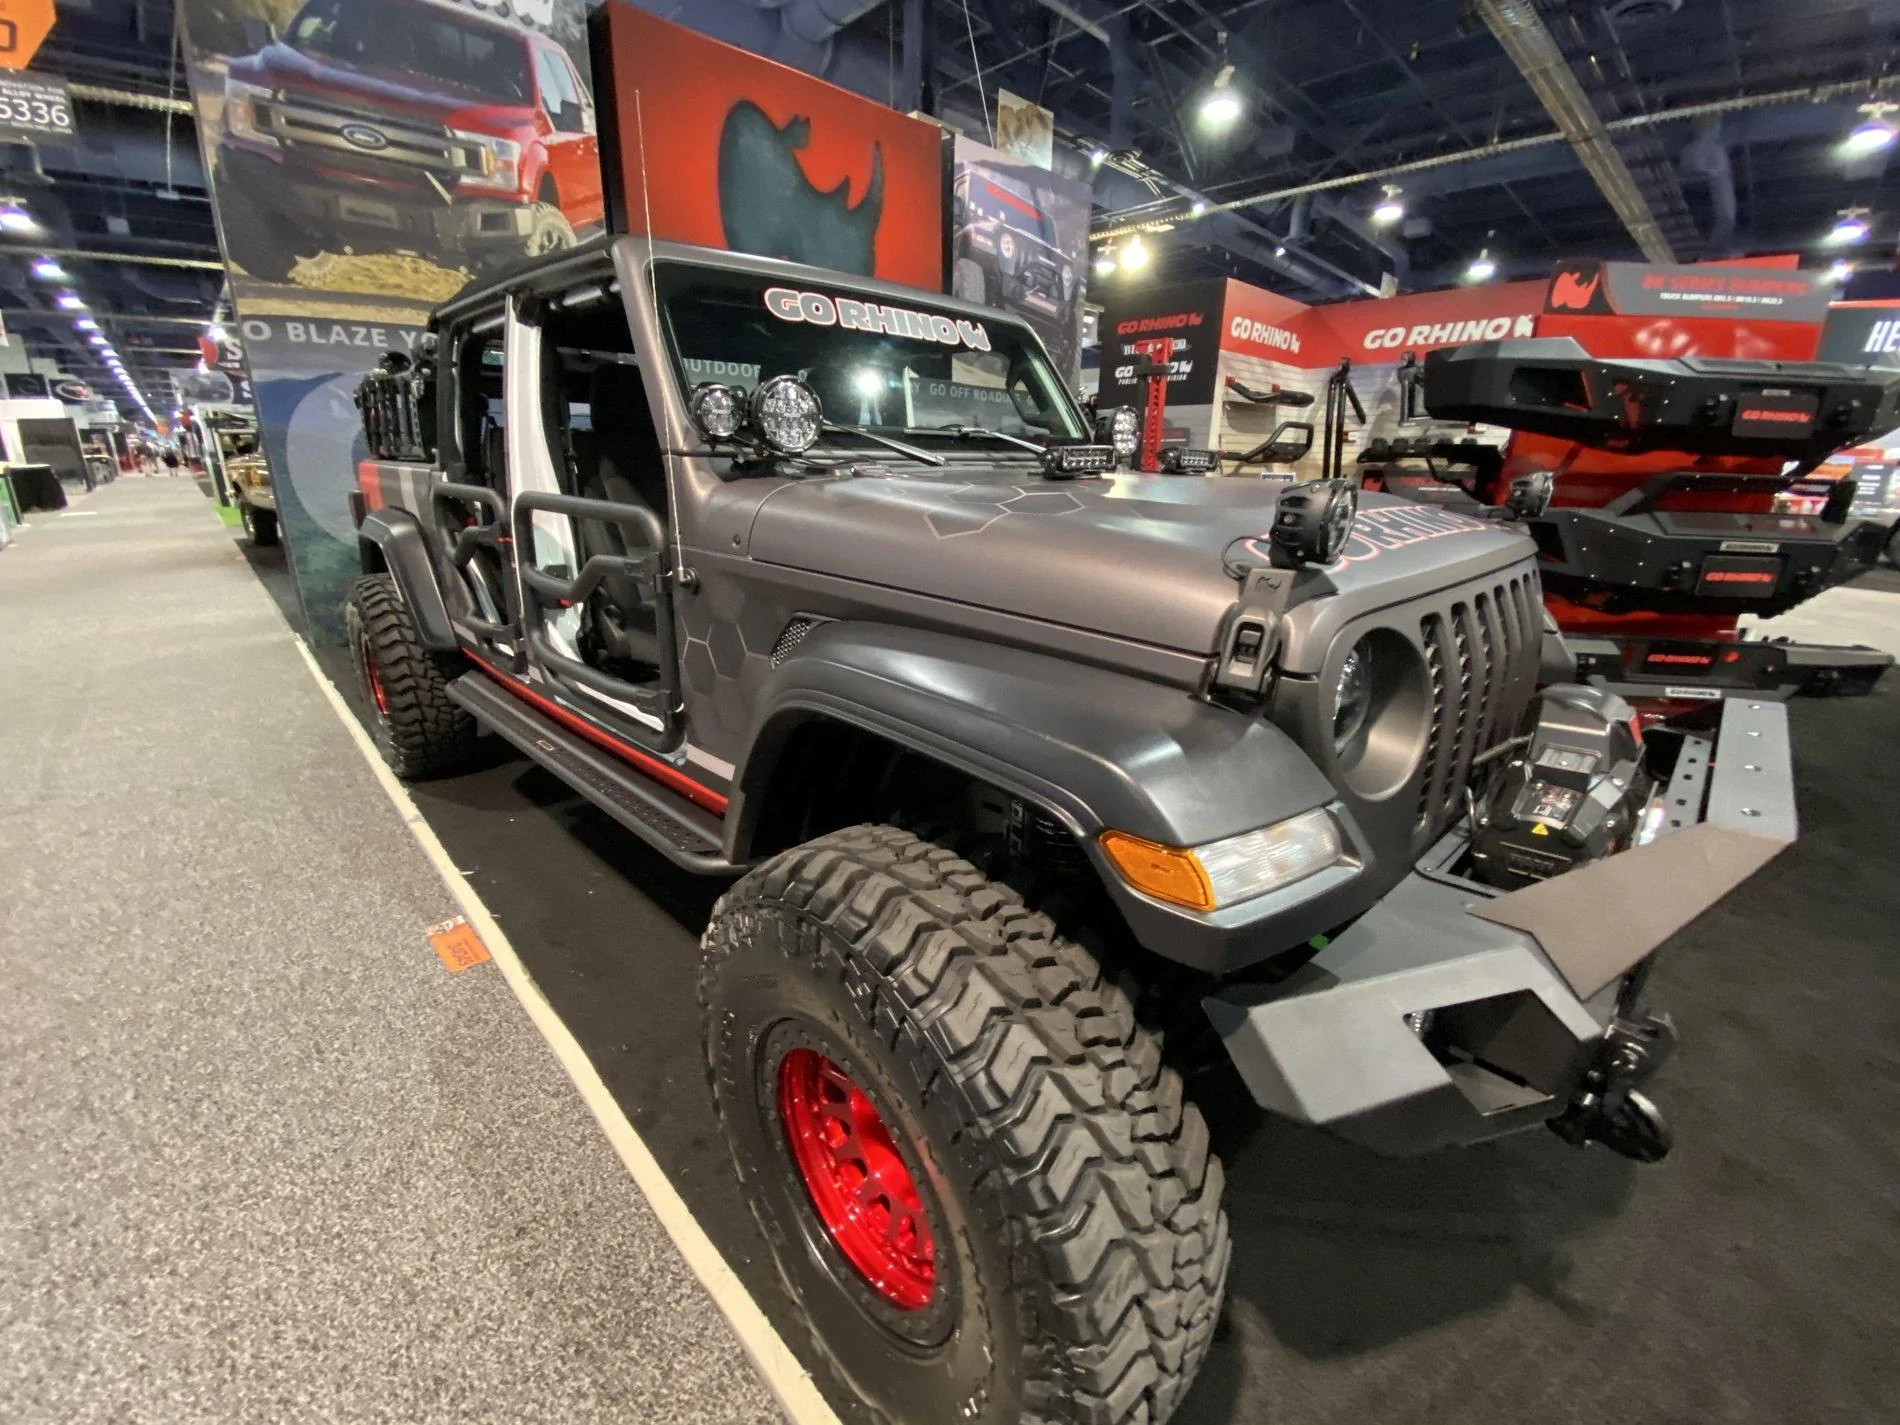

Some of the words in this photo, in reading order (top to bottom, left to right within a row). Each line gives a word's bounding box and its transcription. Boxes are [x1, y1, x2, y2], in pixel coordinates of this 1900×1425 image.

[764, 287, 837, 326] GO
[835, 297, 961, 345] RHINO
[1117, 321, 1140, 335] GO
[1138, 313, 1188, 332] RHINO
[285, 321, 388, 348] BLAZE
[1231, 315, 1252, 340] GO
[1250, 320, 1291, 350] RHINO
[1363, 326, 1406, 350] GO
[1406, 316, 1512, 346] RHINO
[1114, 365, 1134, 379] GO
[929, 383, 946, 396] GO
[950, 385, 971, 399] OFF
